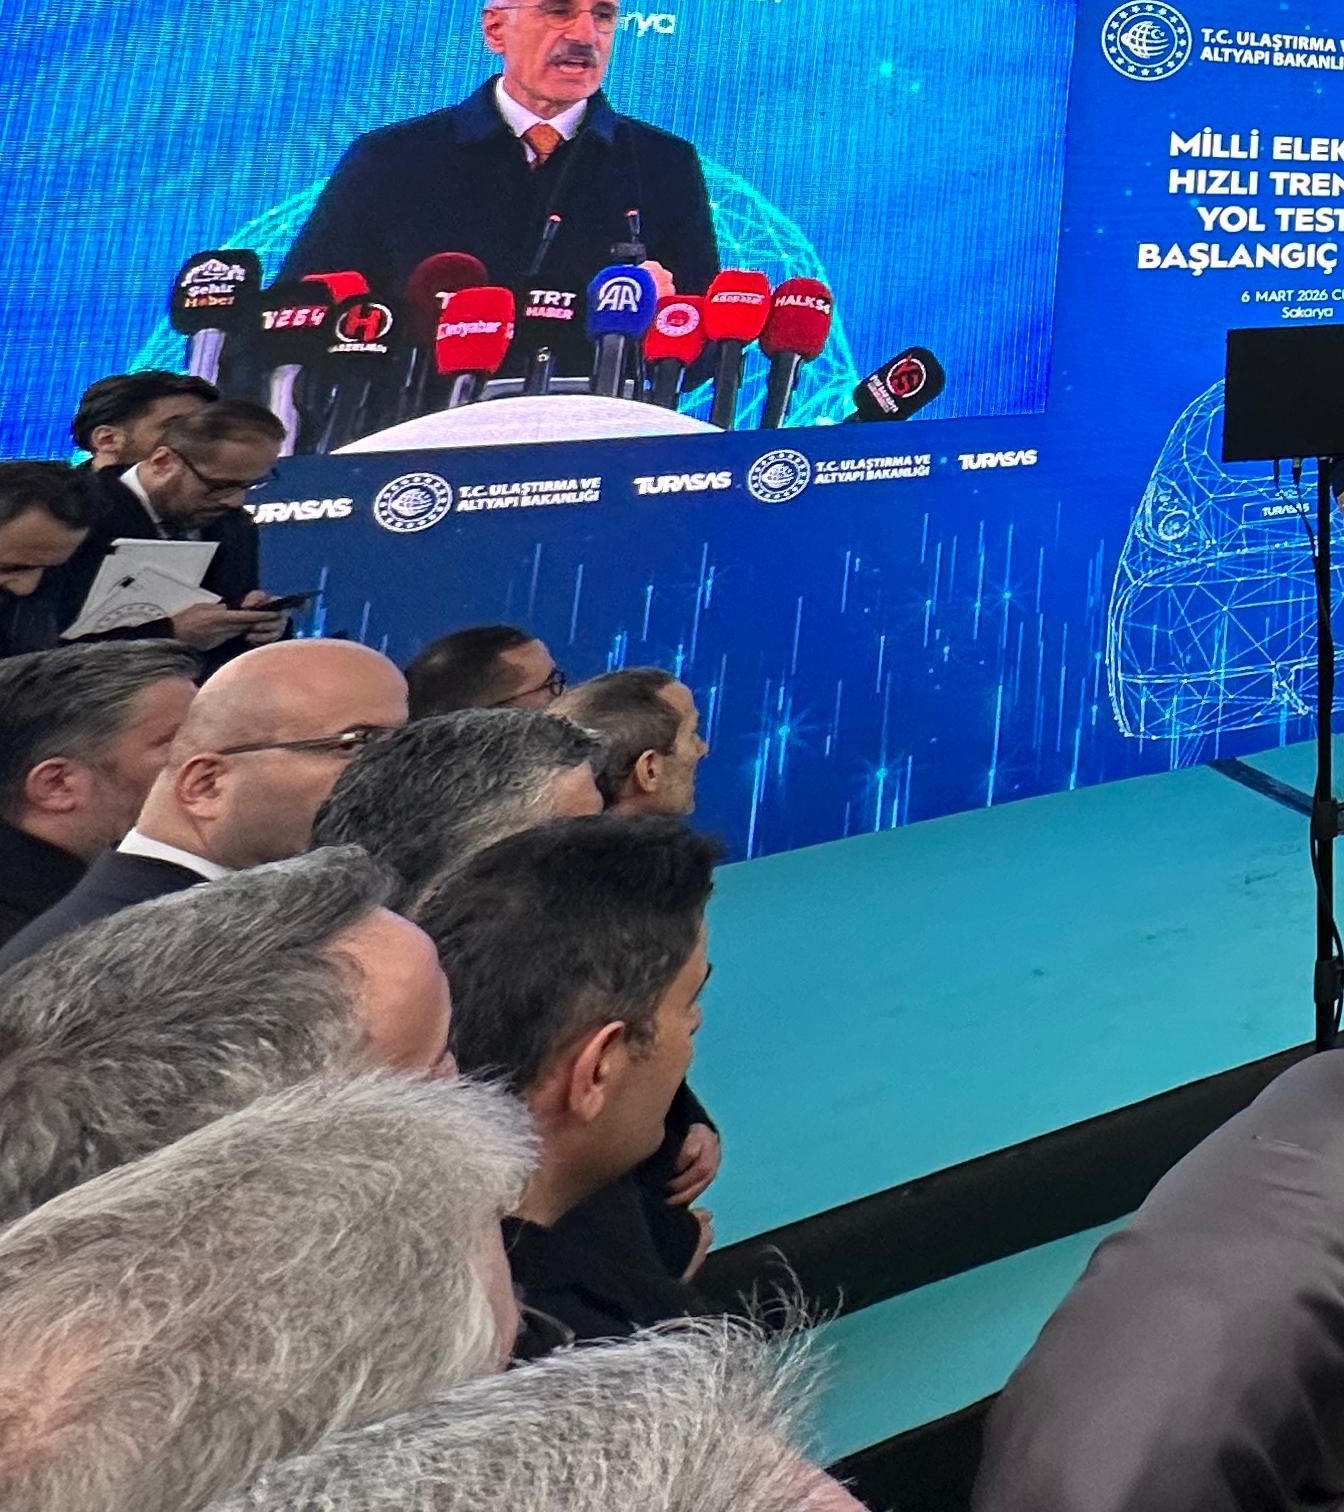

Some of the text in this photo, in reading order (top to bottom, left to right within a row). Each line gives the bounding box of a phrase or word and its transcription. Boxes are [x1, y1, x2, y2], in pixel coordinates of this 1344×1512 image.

[1200, 27, 1233, 45] T.C.
[1236, 31, 1335, 53] ULAŞTIRMA
[1200, 45, 1269, 65] ALTYAPI
[1168, 126, 1260, 160] MİLLİ
[1168, 168, 1258, 196] HIZLI
[1196, 205, 1266, 233] YOL
[1137, 242, 1338, 276] BAŞLANGIÇ
[529, 290, 577, 307] TRT
[1241, 290, 1250, 303] 6
[1255, 290, 1295, 303] MART
[1297, 289, 1329, 302] 2026
[1281, 305, 1334, 320] Sakarya
[814, 464, 931, 484] ALTYAPI BAKANLIĞI
[840, 456, 911, 472] ULAŞTIRMA
[914, 454, 931, 466] VE
[458, 477, 602, 500] T.C. ULAŞTIRMA VE
[457, 489, 601, 512] ALTYAPI BAKANLIĞI
